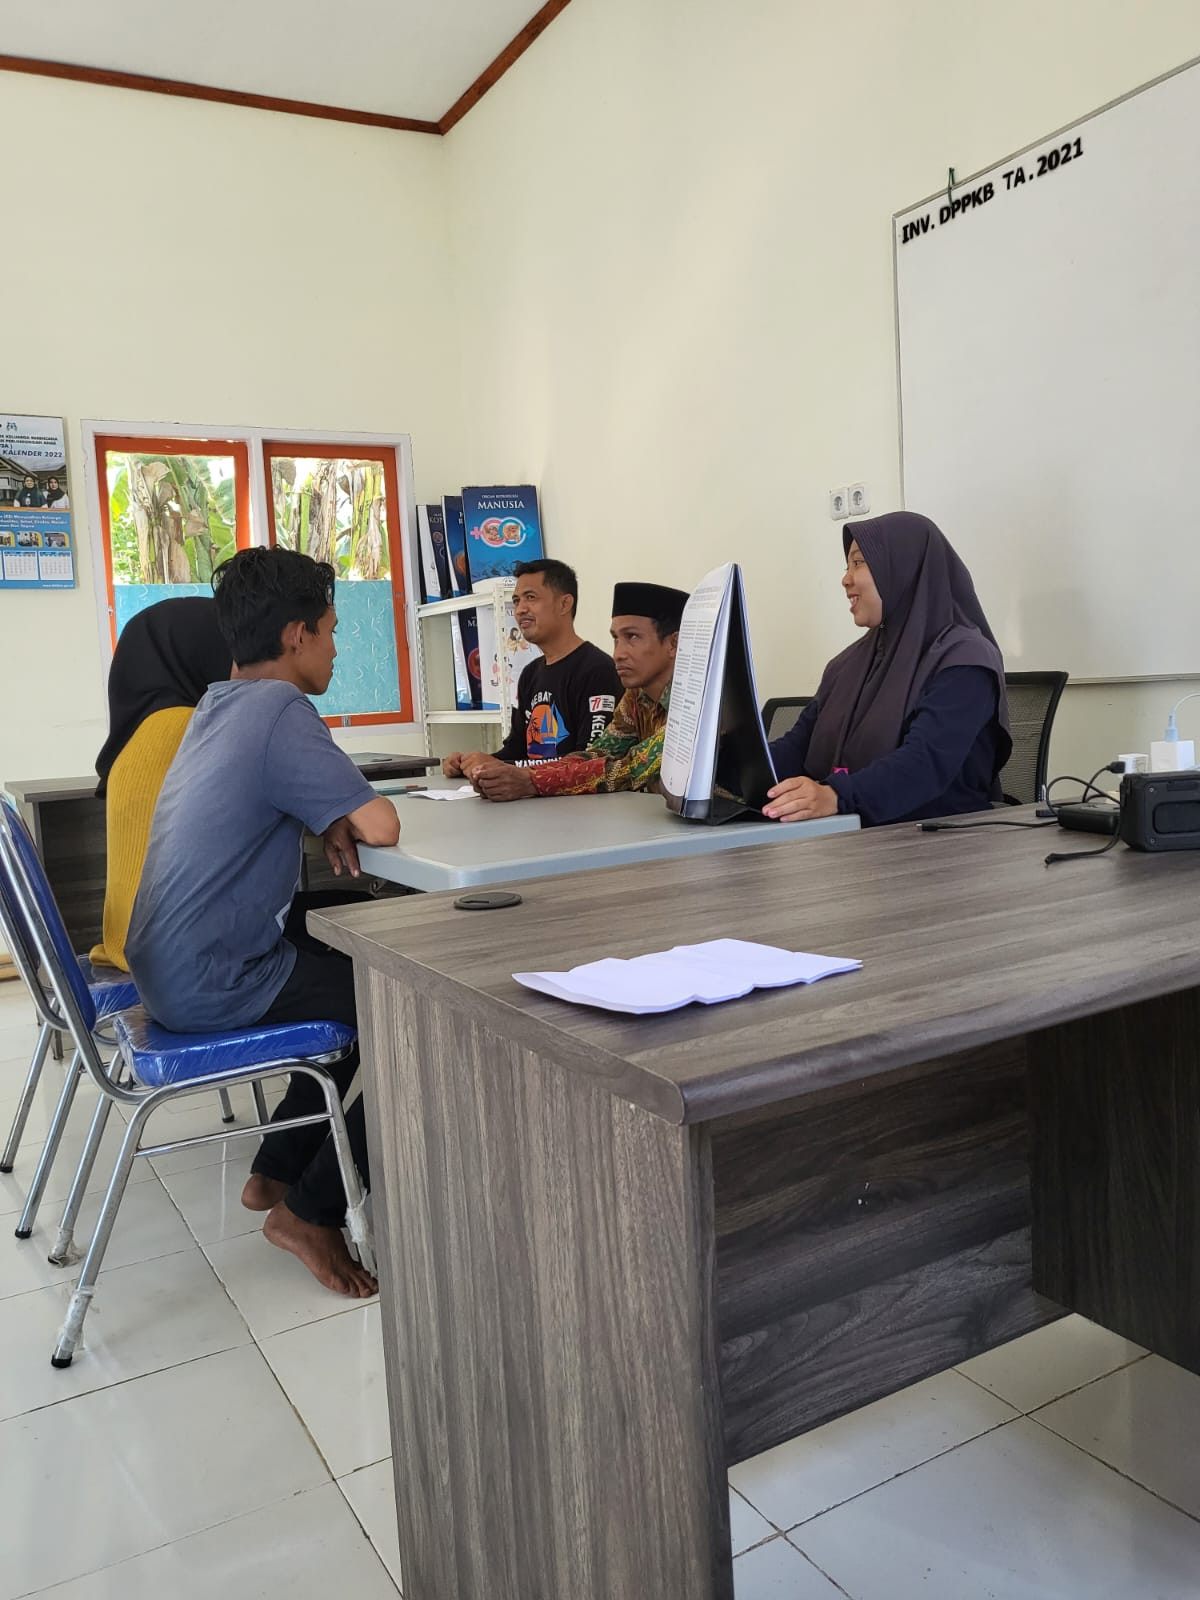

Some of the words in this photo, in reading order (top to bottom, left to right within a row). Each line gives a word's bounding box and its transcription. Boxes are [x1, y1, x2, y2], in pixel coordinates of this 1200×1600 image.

[902, 214, 935, 244] INV.
[939, 182, 994, 225] DPPKB
[477, 500, 525, 510] MANUSIA
[590, 715, 606, 741] KEC.
